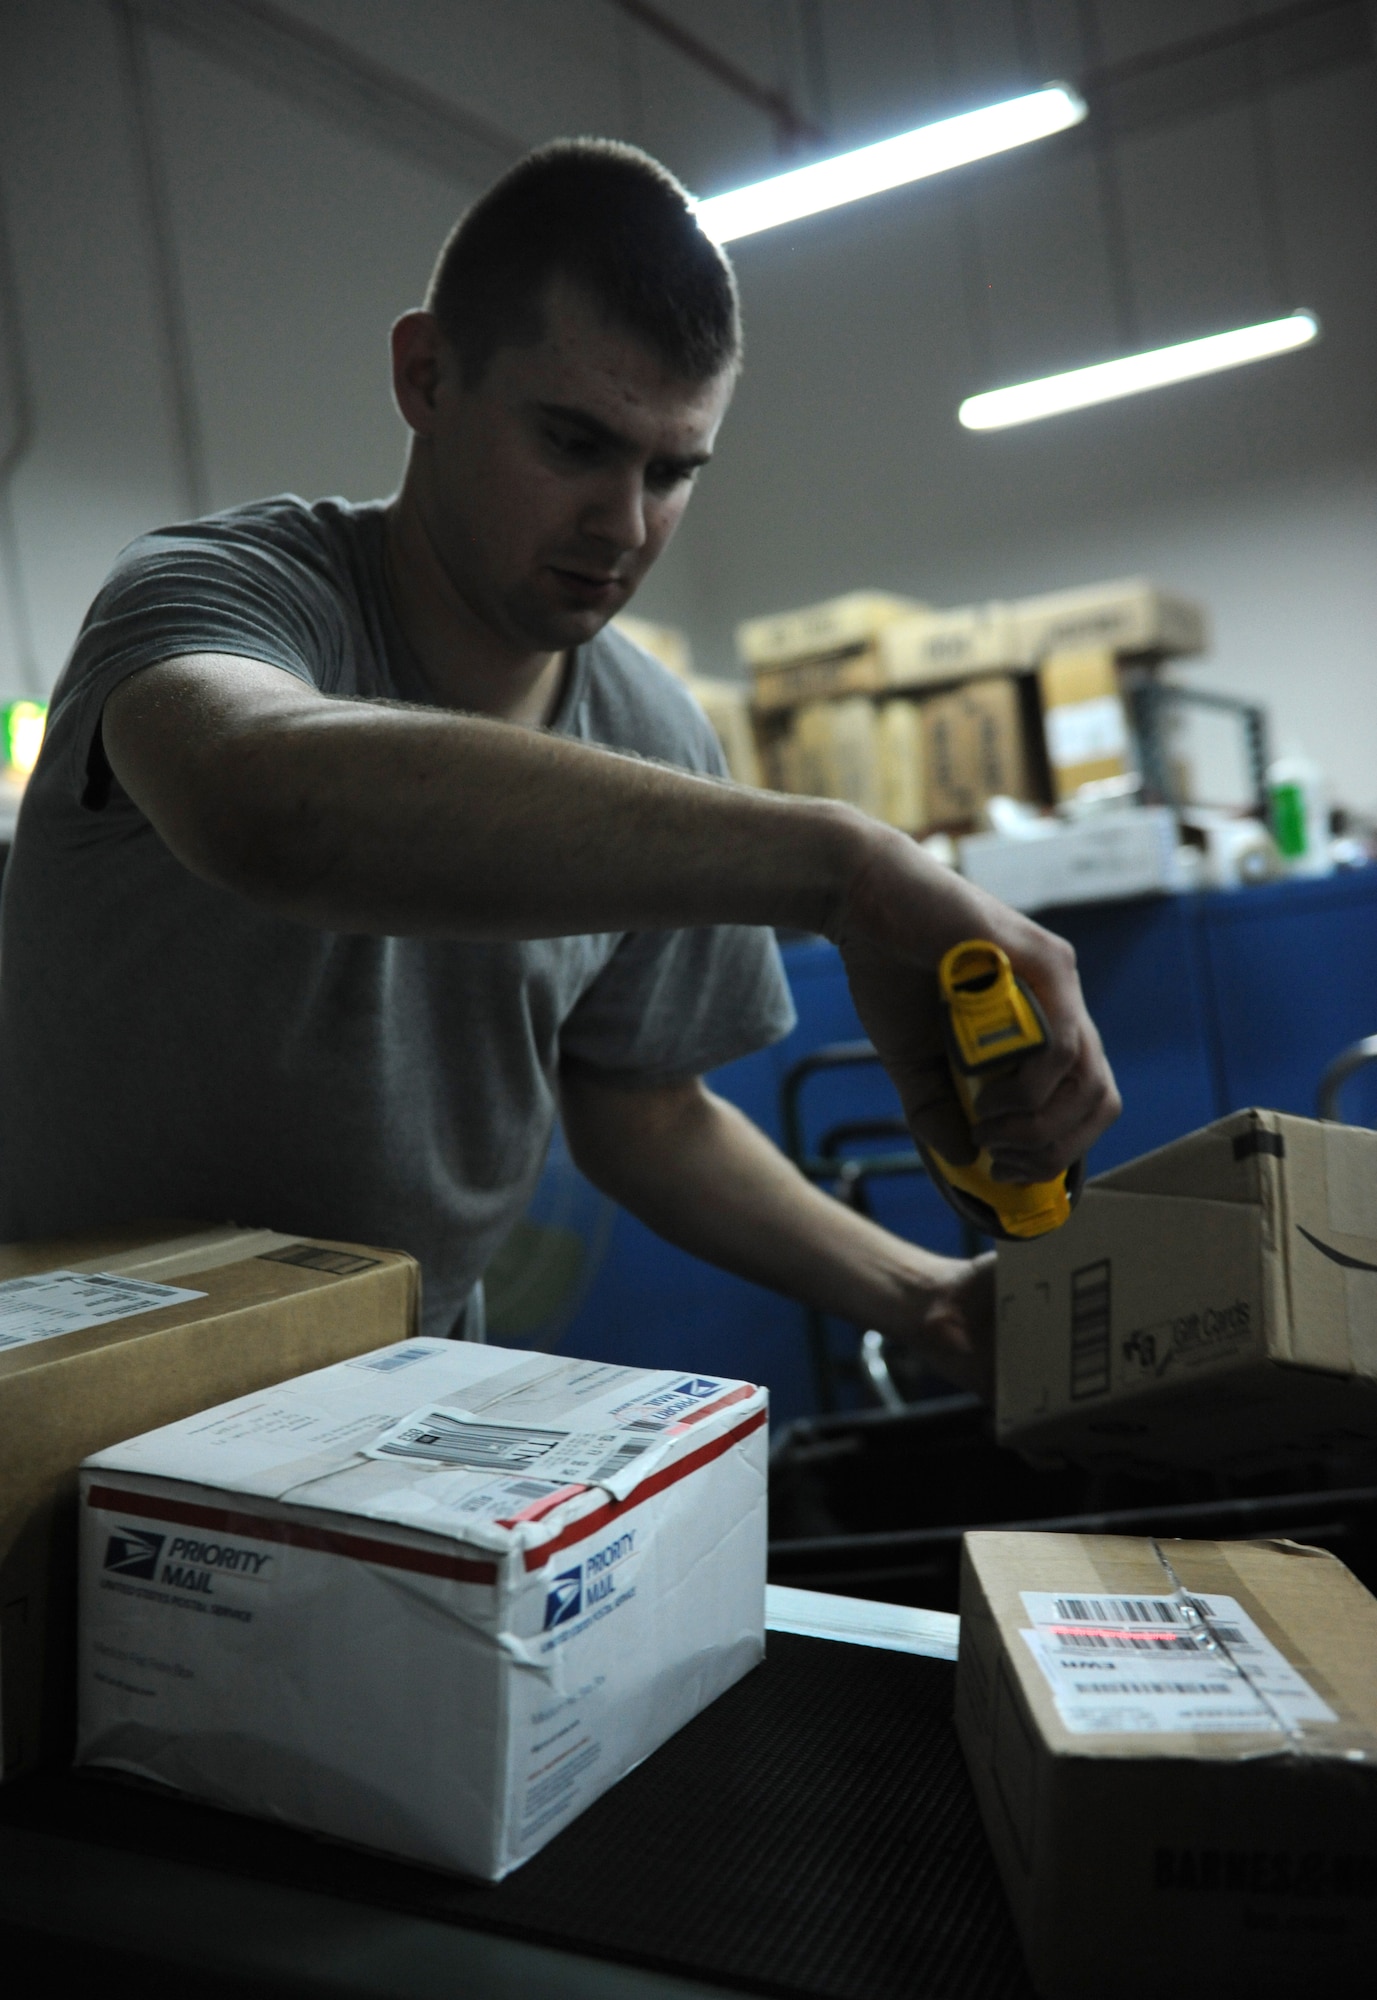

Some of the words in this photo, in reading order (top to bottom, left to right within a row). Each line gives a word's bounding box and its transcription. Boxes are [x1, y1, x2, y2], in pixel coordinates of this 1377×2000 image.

[642, 1393, 681, 1406] MAIL
[651, 1397, 700, 1420] PRIORIT
[511, 1441, 559, 1464] TTN
[168, 1538, 271, 1574] PRIORITY
[587, 1531, 635, 1577] PRIORITY
[161, 1565, 213, 1594] MAIL
[587, 1574, 616, 1607] MAIL
